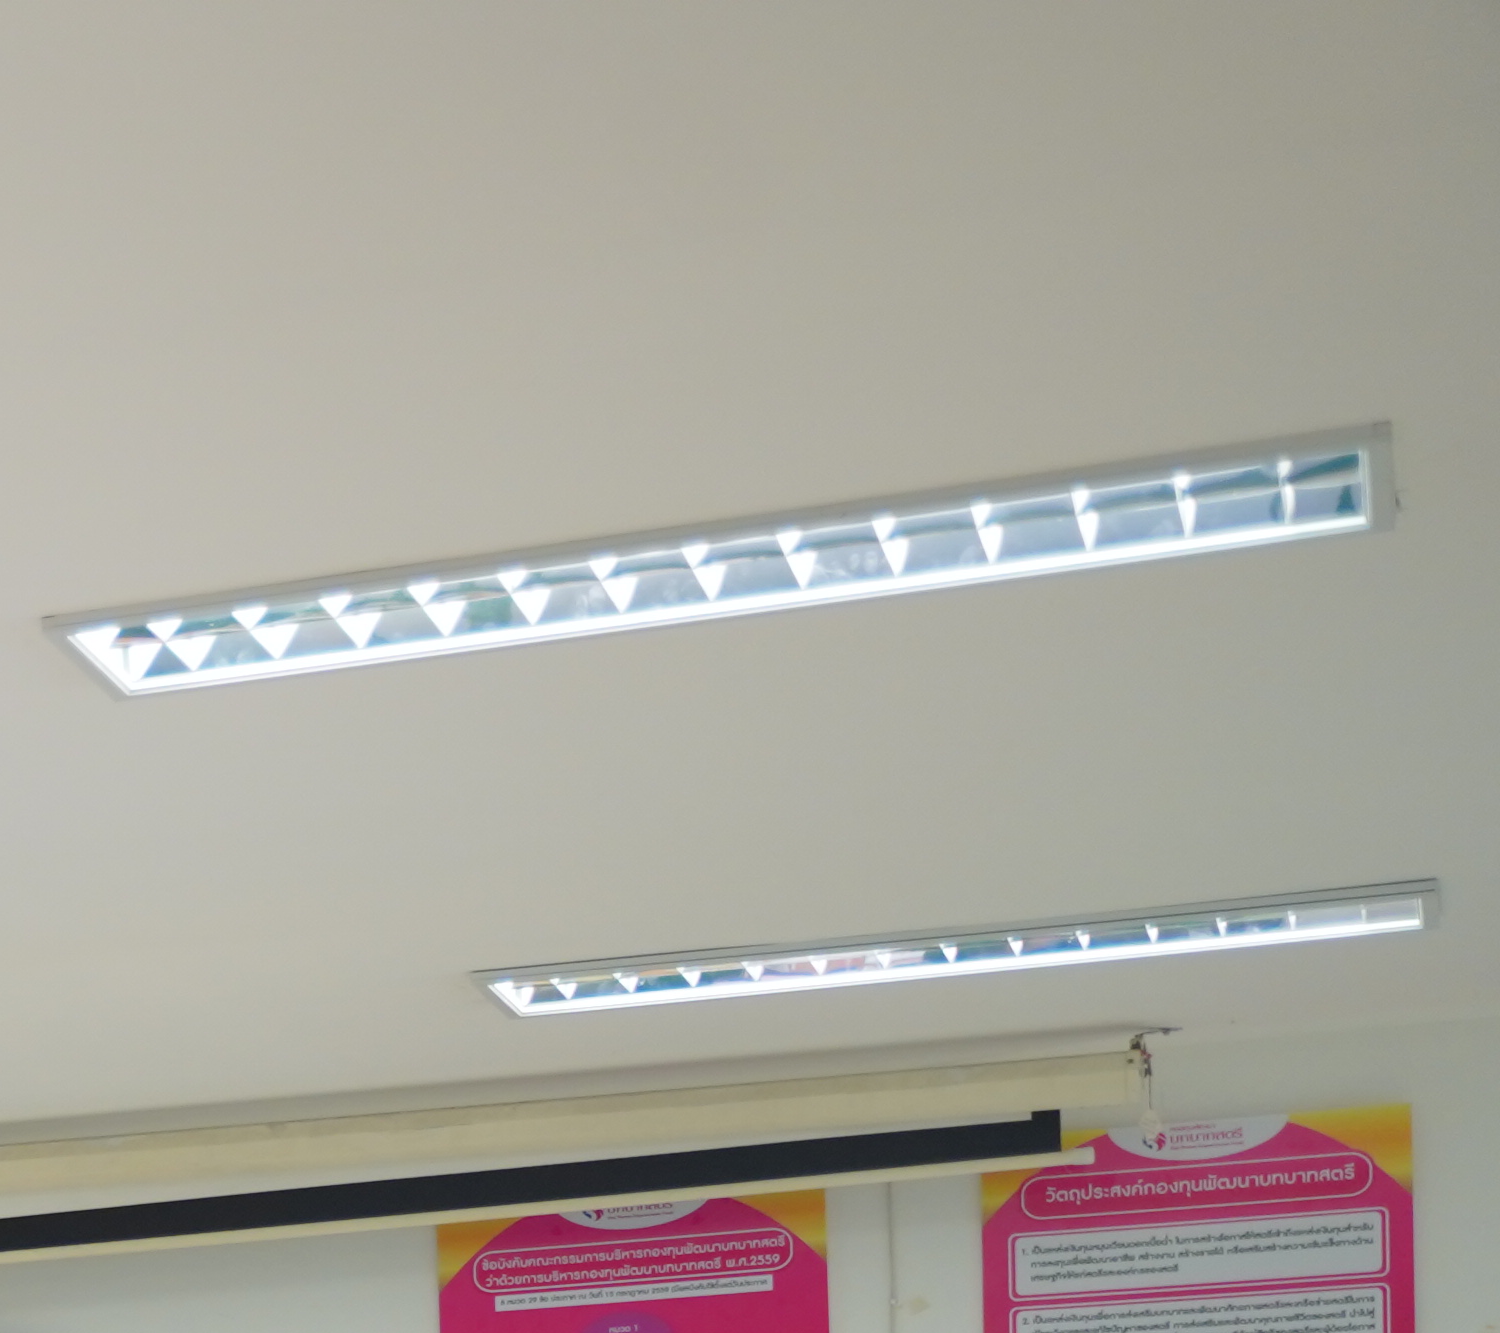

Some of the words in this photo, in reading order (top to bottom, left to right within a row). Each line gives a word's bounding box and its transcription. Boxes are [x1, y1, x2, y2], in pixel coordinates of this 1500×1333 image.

[1046, 1163, 1355, 1205] วัตถุประสงค์กองทุนพัฒนาบทบาทสตรี
[481, 1235, 785, 1271] ข้อบังคับคณะกรรมการบริหารกองทุนพัฒนาบทบาทสตรี
[486, 1258, 721, 1288] ว่าด้วยการบริหารกองทุนพัฒนาบทบาทสตรี
[726, 1254, 780, 1267] พ.ศ.2559
